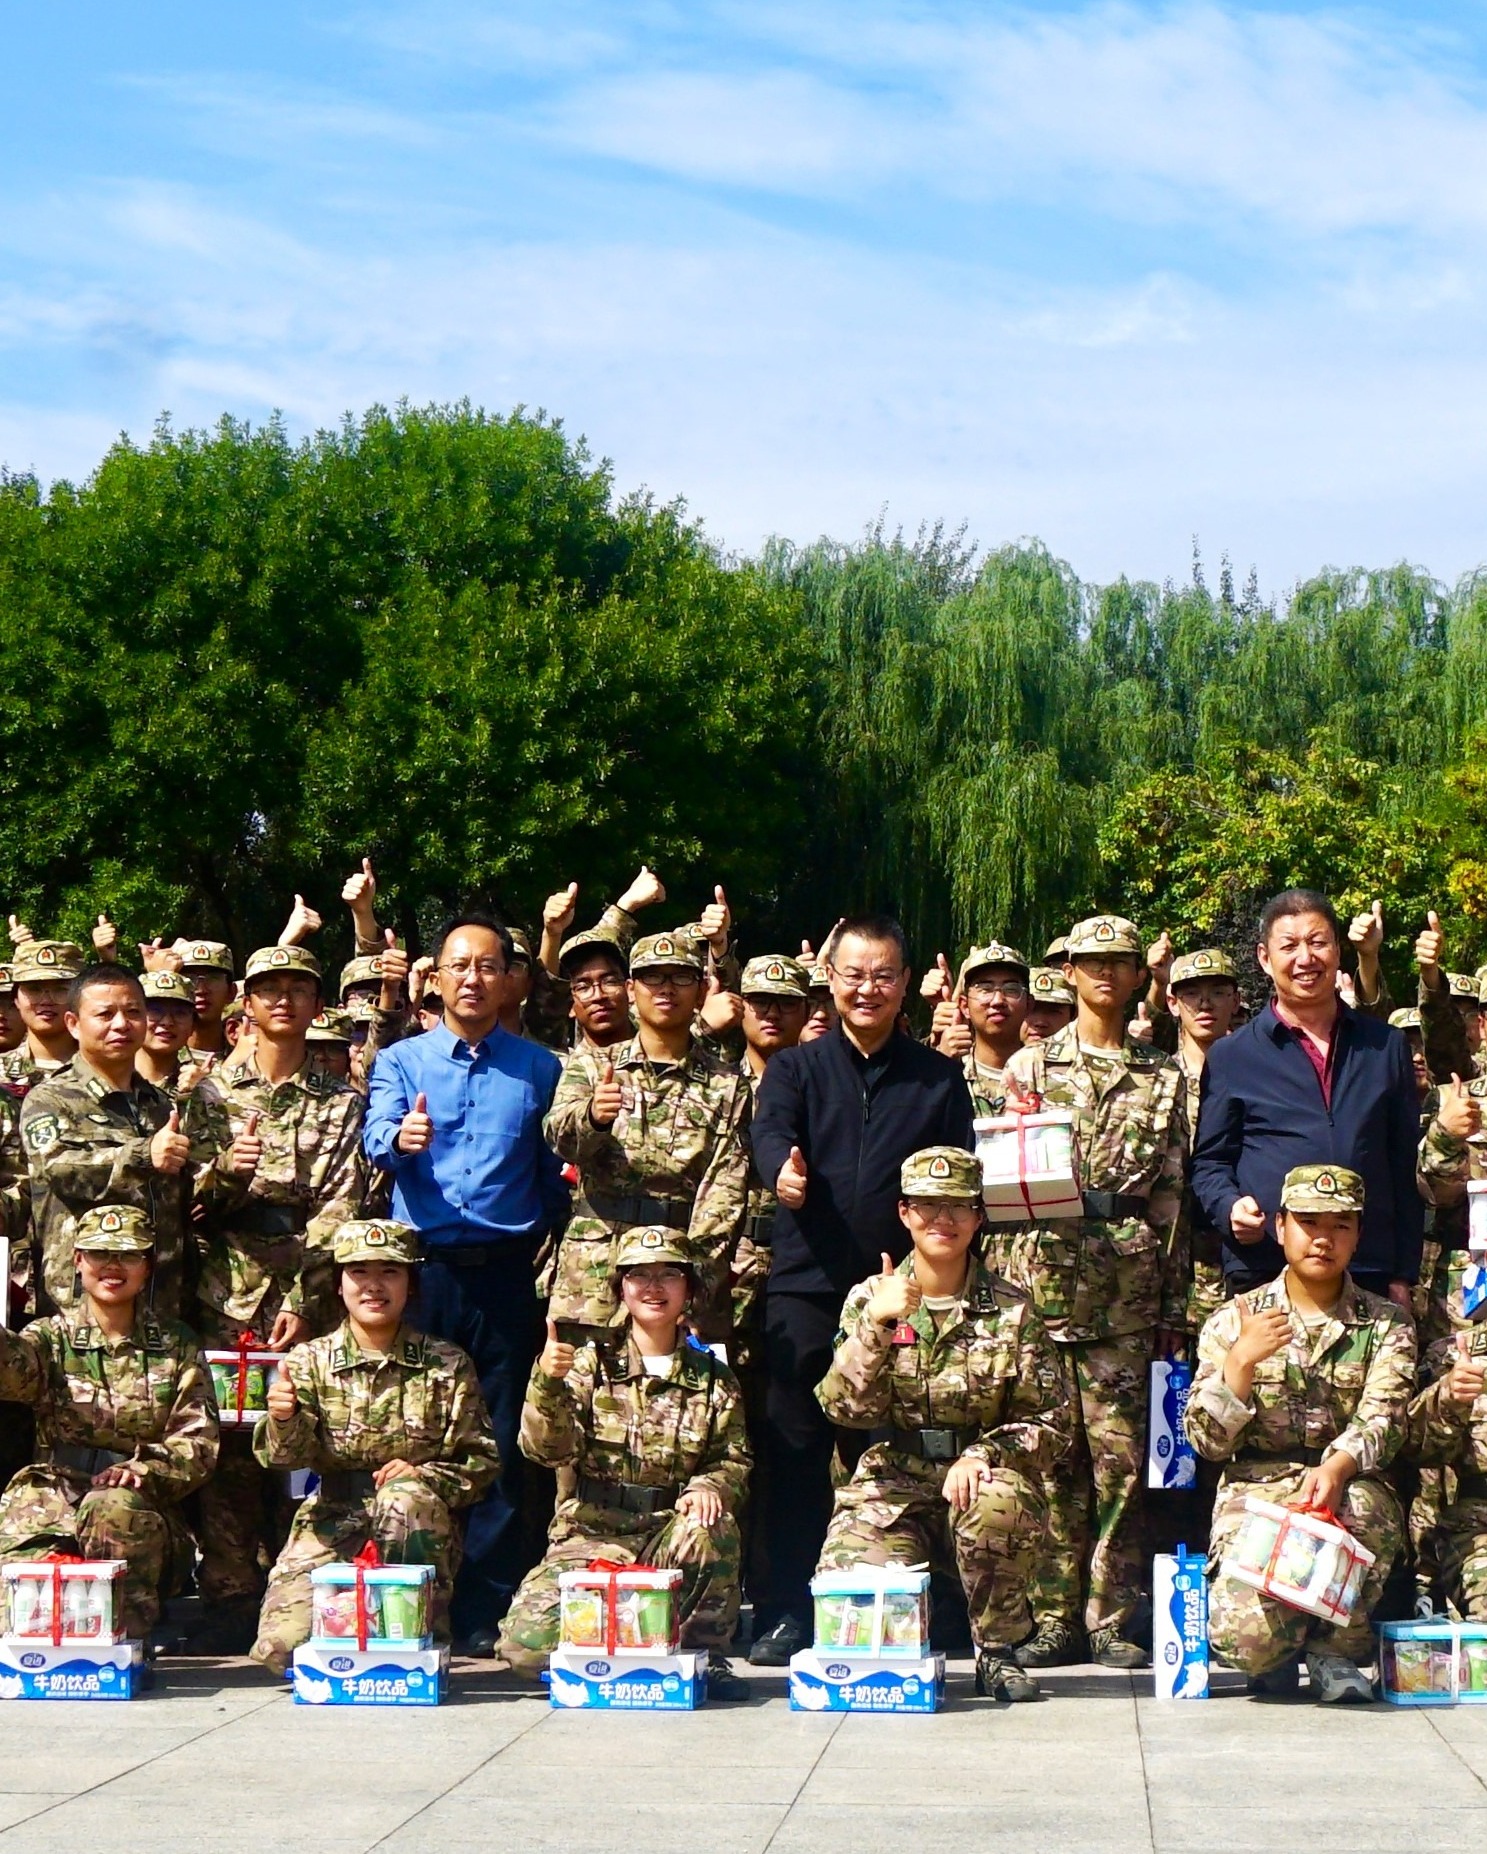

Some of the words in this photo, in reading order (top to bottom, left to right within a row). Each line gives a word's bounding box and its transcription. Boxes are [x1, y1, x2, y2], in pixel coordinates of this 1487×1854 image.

[1184, 1589, 1200, 1653] 牛奶饮品
[34, 1674, 100, 1692] 牛奶饮品
[342, 1678, 408, 1696] 牛奶饮品
[598, 1683, 665, 1701] 牛奶饮品
[839, 1686, 905, 1704] 牛奶饮品
